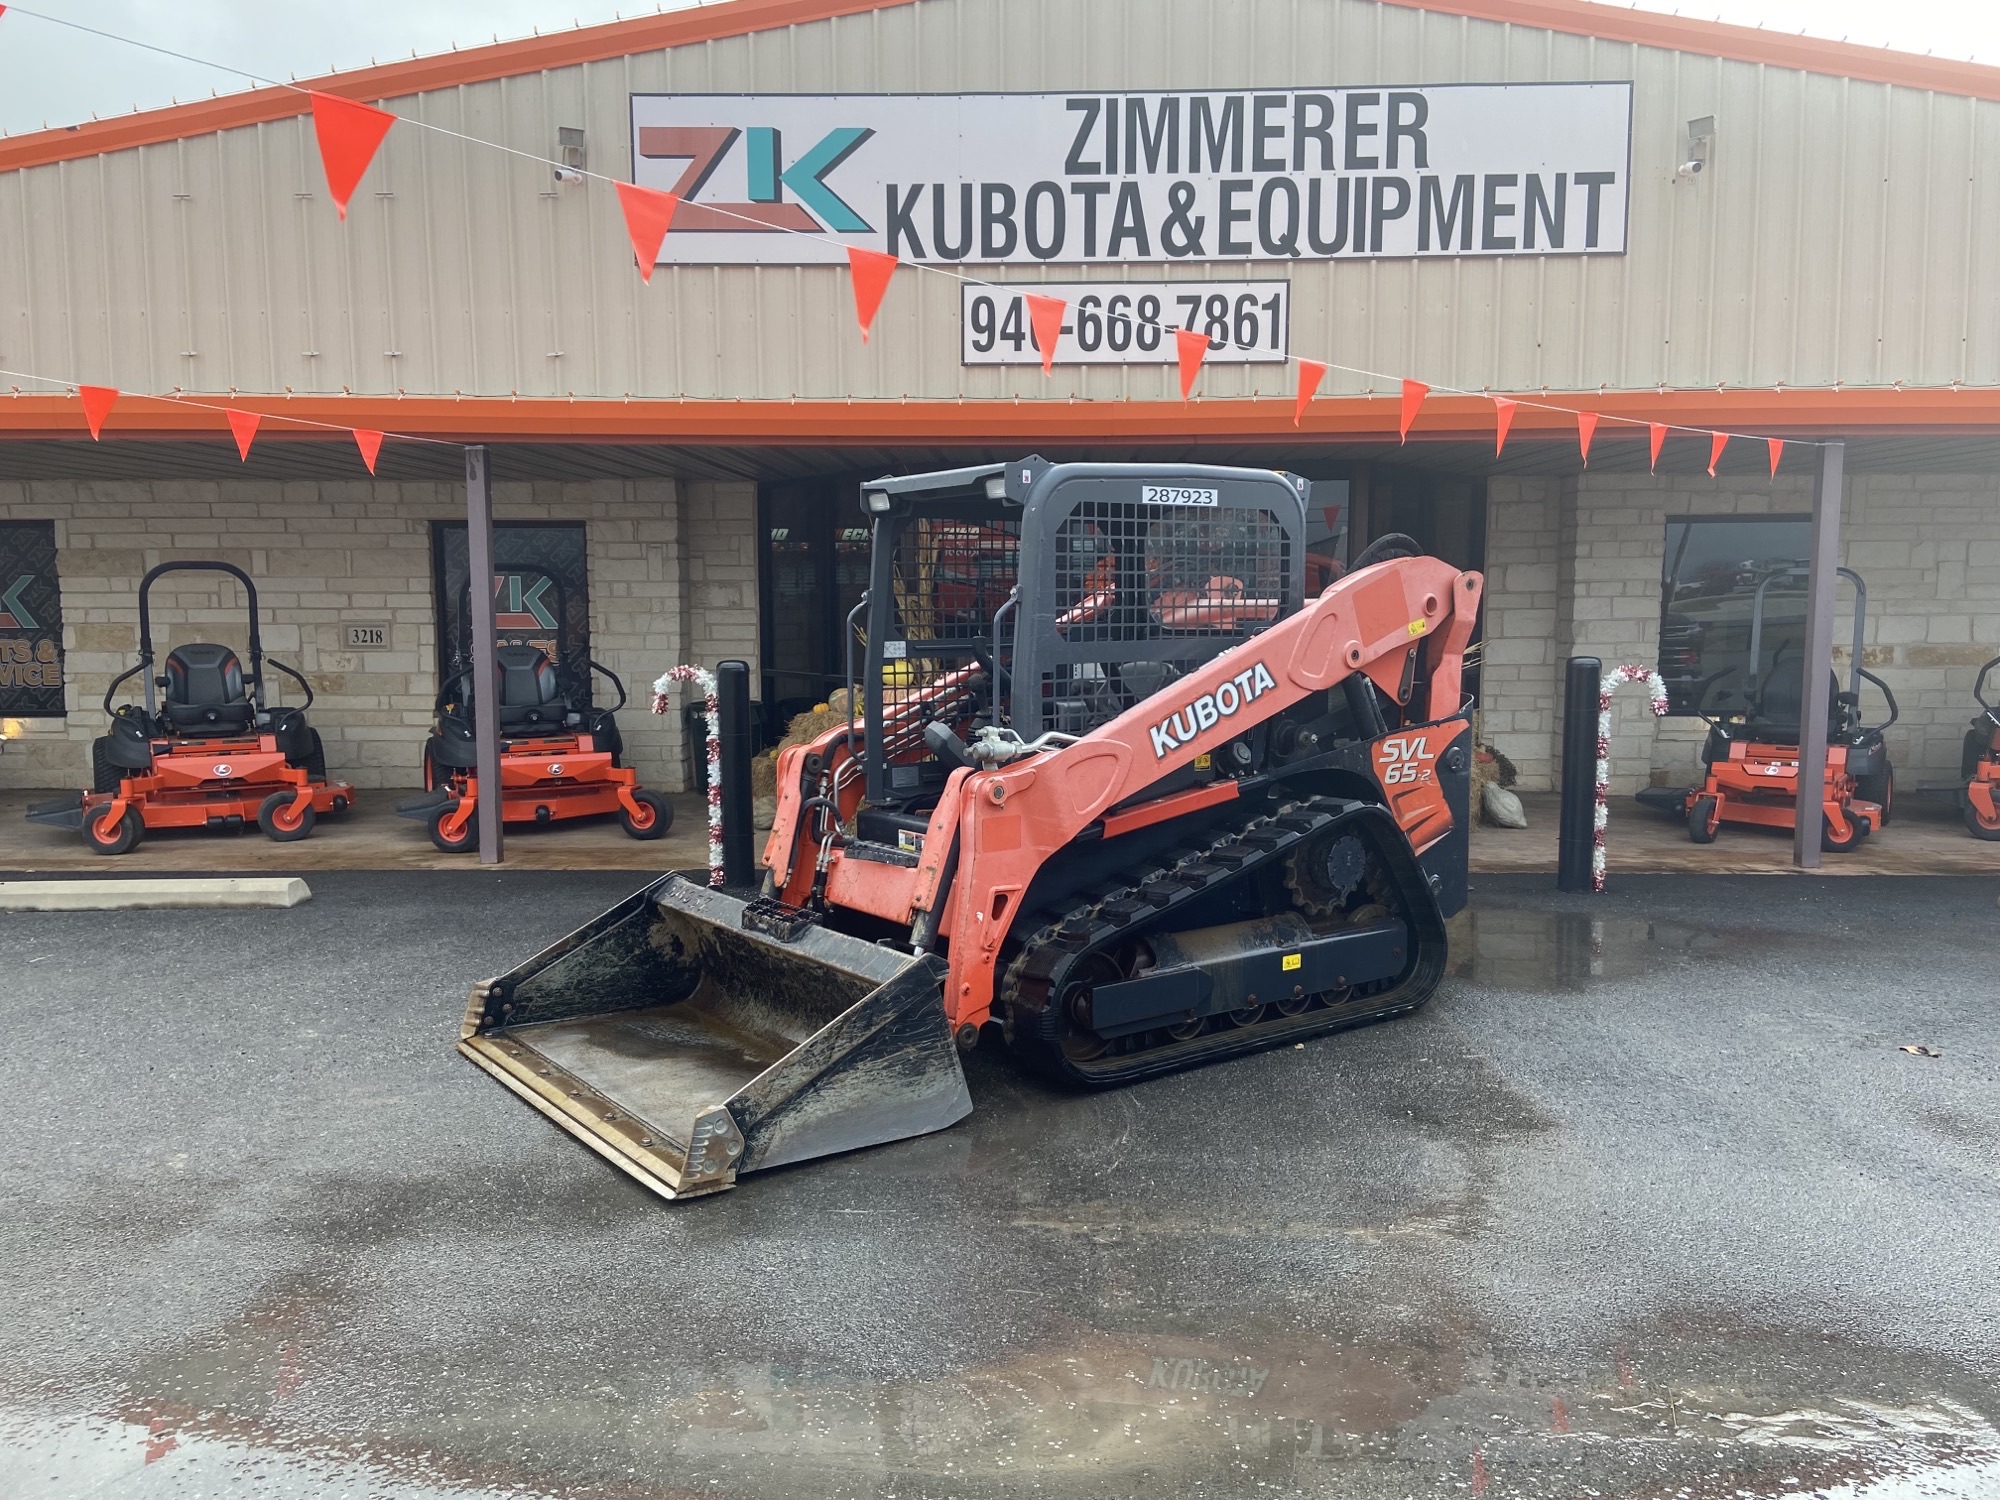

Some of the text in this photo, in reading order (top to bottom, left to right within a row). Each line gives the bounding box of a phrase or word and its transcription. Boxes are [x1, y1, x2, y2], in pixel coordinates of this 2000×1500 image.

[1065, 92, 1430, 175] ZIMMERER
[886, 181, 1151, 260] KUBOTA
[1218, 172, 1615, 257] EQUIPMENT
[971, 293, 1281, 352] 94-668-7861
[1148, 488, 1213, 504] 287923
[352, 629, 383, 644] 3218
[1149, 661, 1276, 759] KUBOTA
[1379, 737, 1435, 763] SVL
